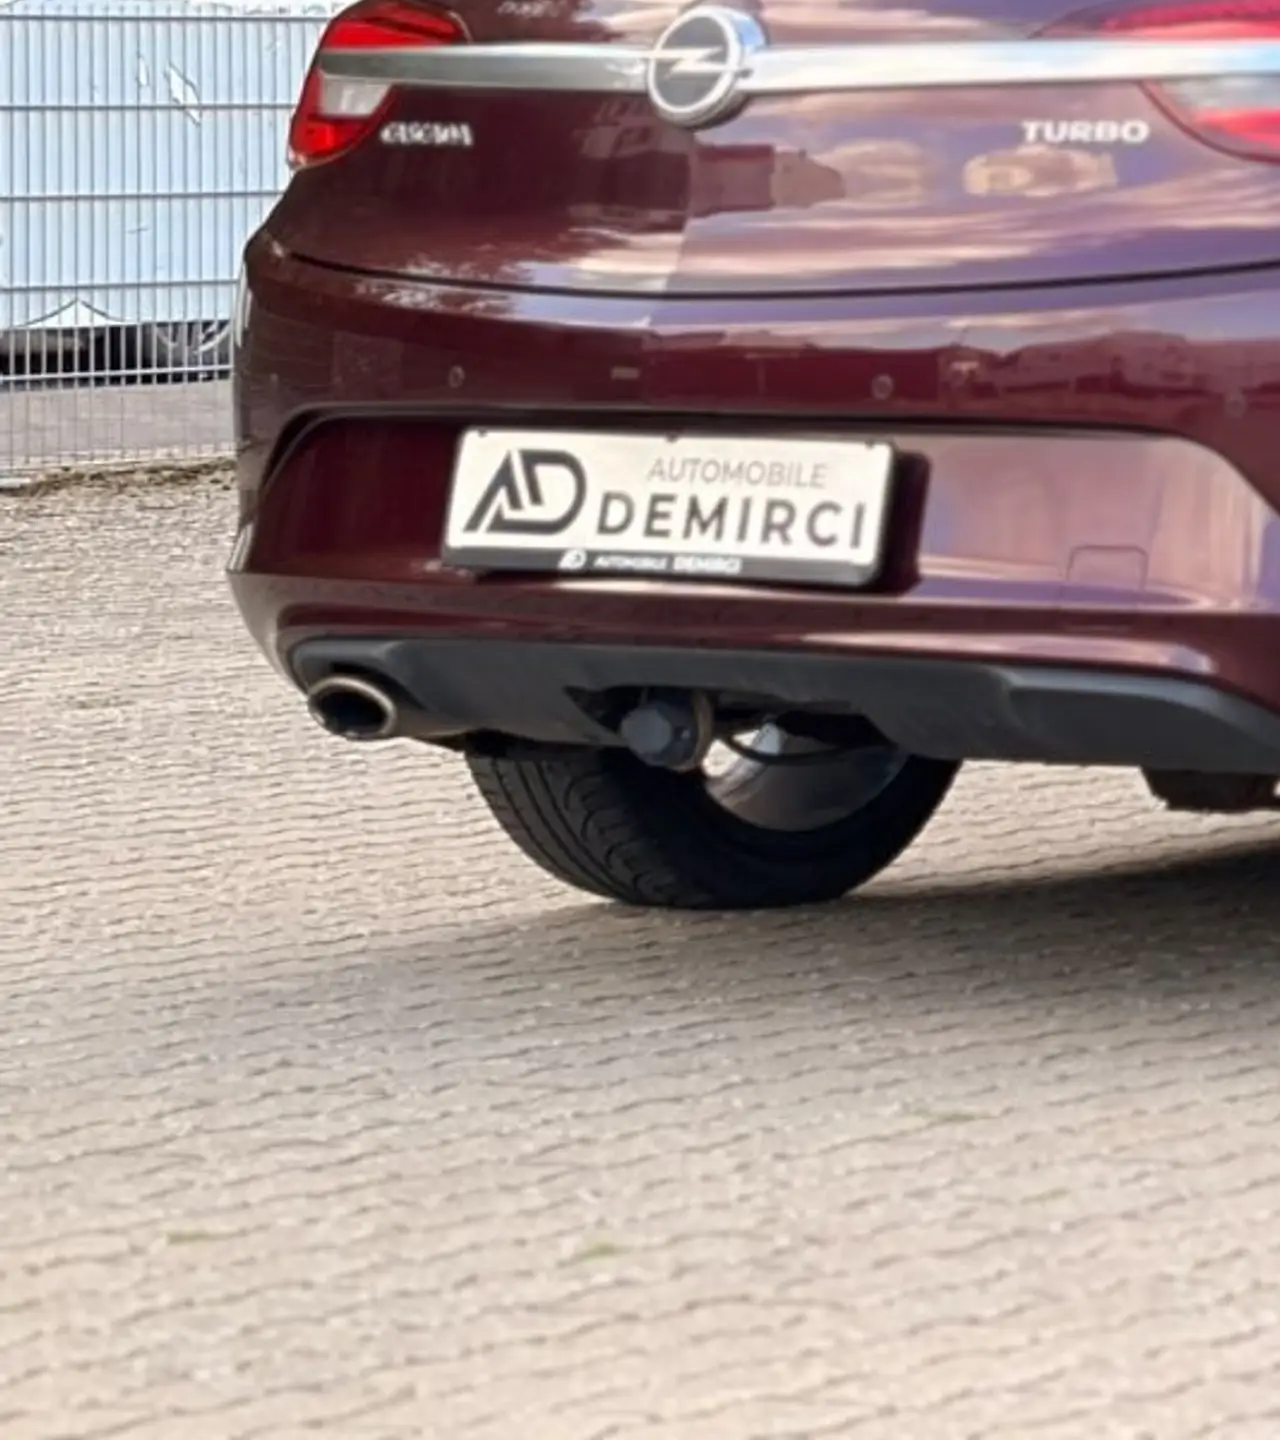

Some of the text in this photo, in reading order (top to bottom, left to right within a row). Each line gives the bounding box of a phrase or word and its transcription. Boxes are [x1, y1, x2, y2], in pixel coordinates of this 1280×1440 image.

[1022, 119, 1151, 144] TURBO
[647, 457, 829, 488] AUTOMOBILE
[597, 491, 867, 549] DEMIRCI
